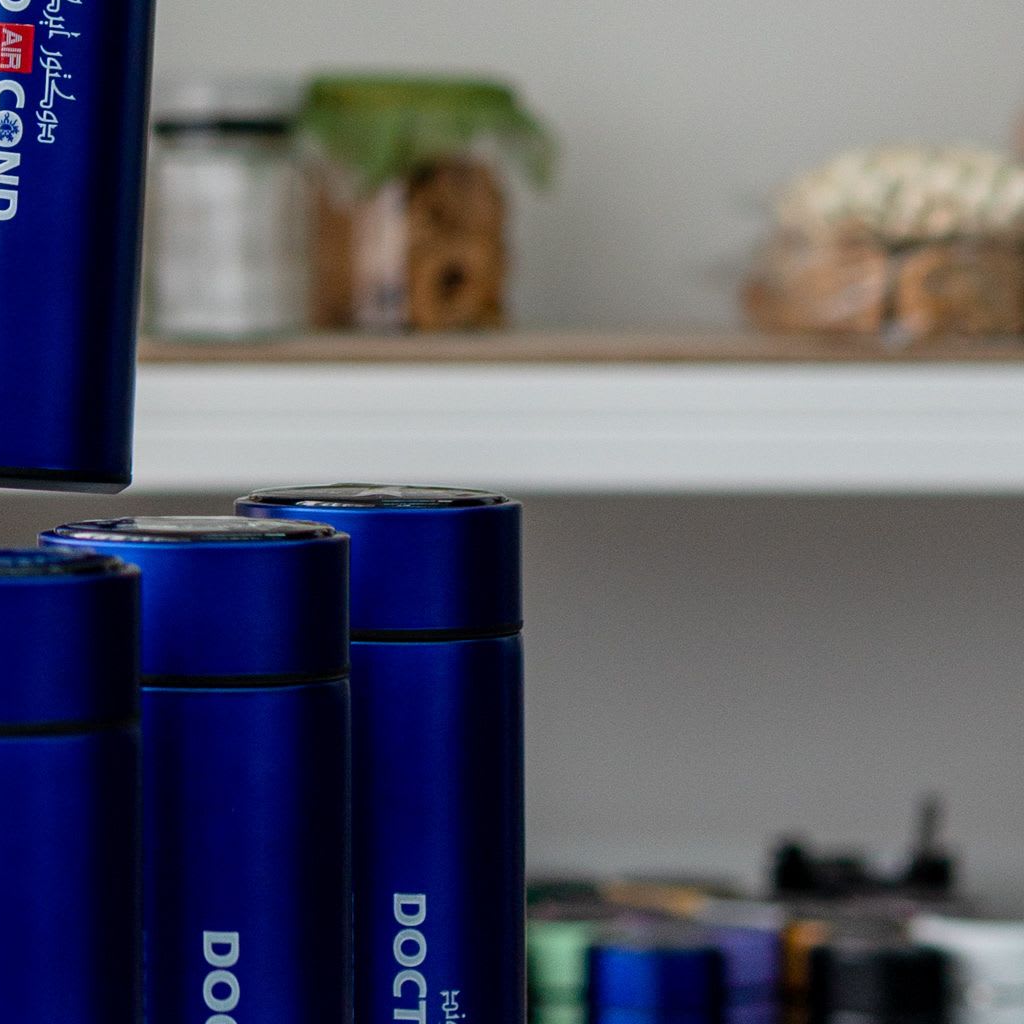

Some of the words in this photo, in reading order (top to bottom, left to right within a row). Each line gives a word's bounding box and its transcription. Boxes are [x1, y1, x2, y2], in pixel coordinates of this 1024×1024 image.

[0, 27, 24, 70] AIR
[203, 931, 240, 1024] DO
[393, 893, 427, 1024] DOCT
